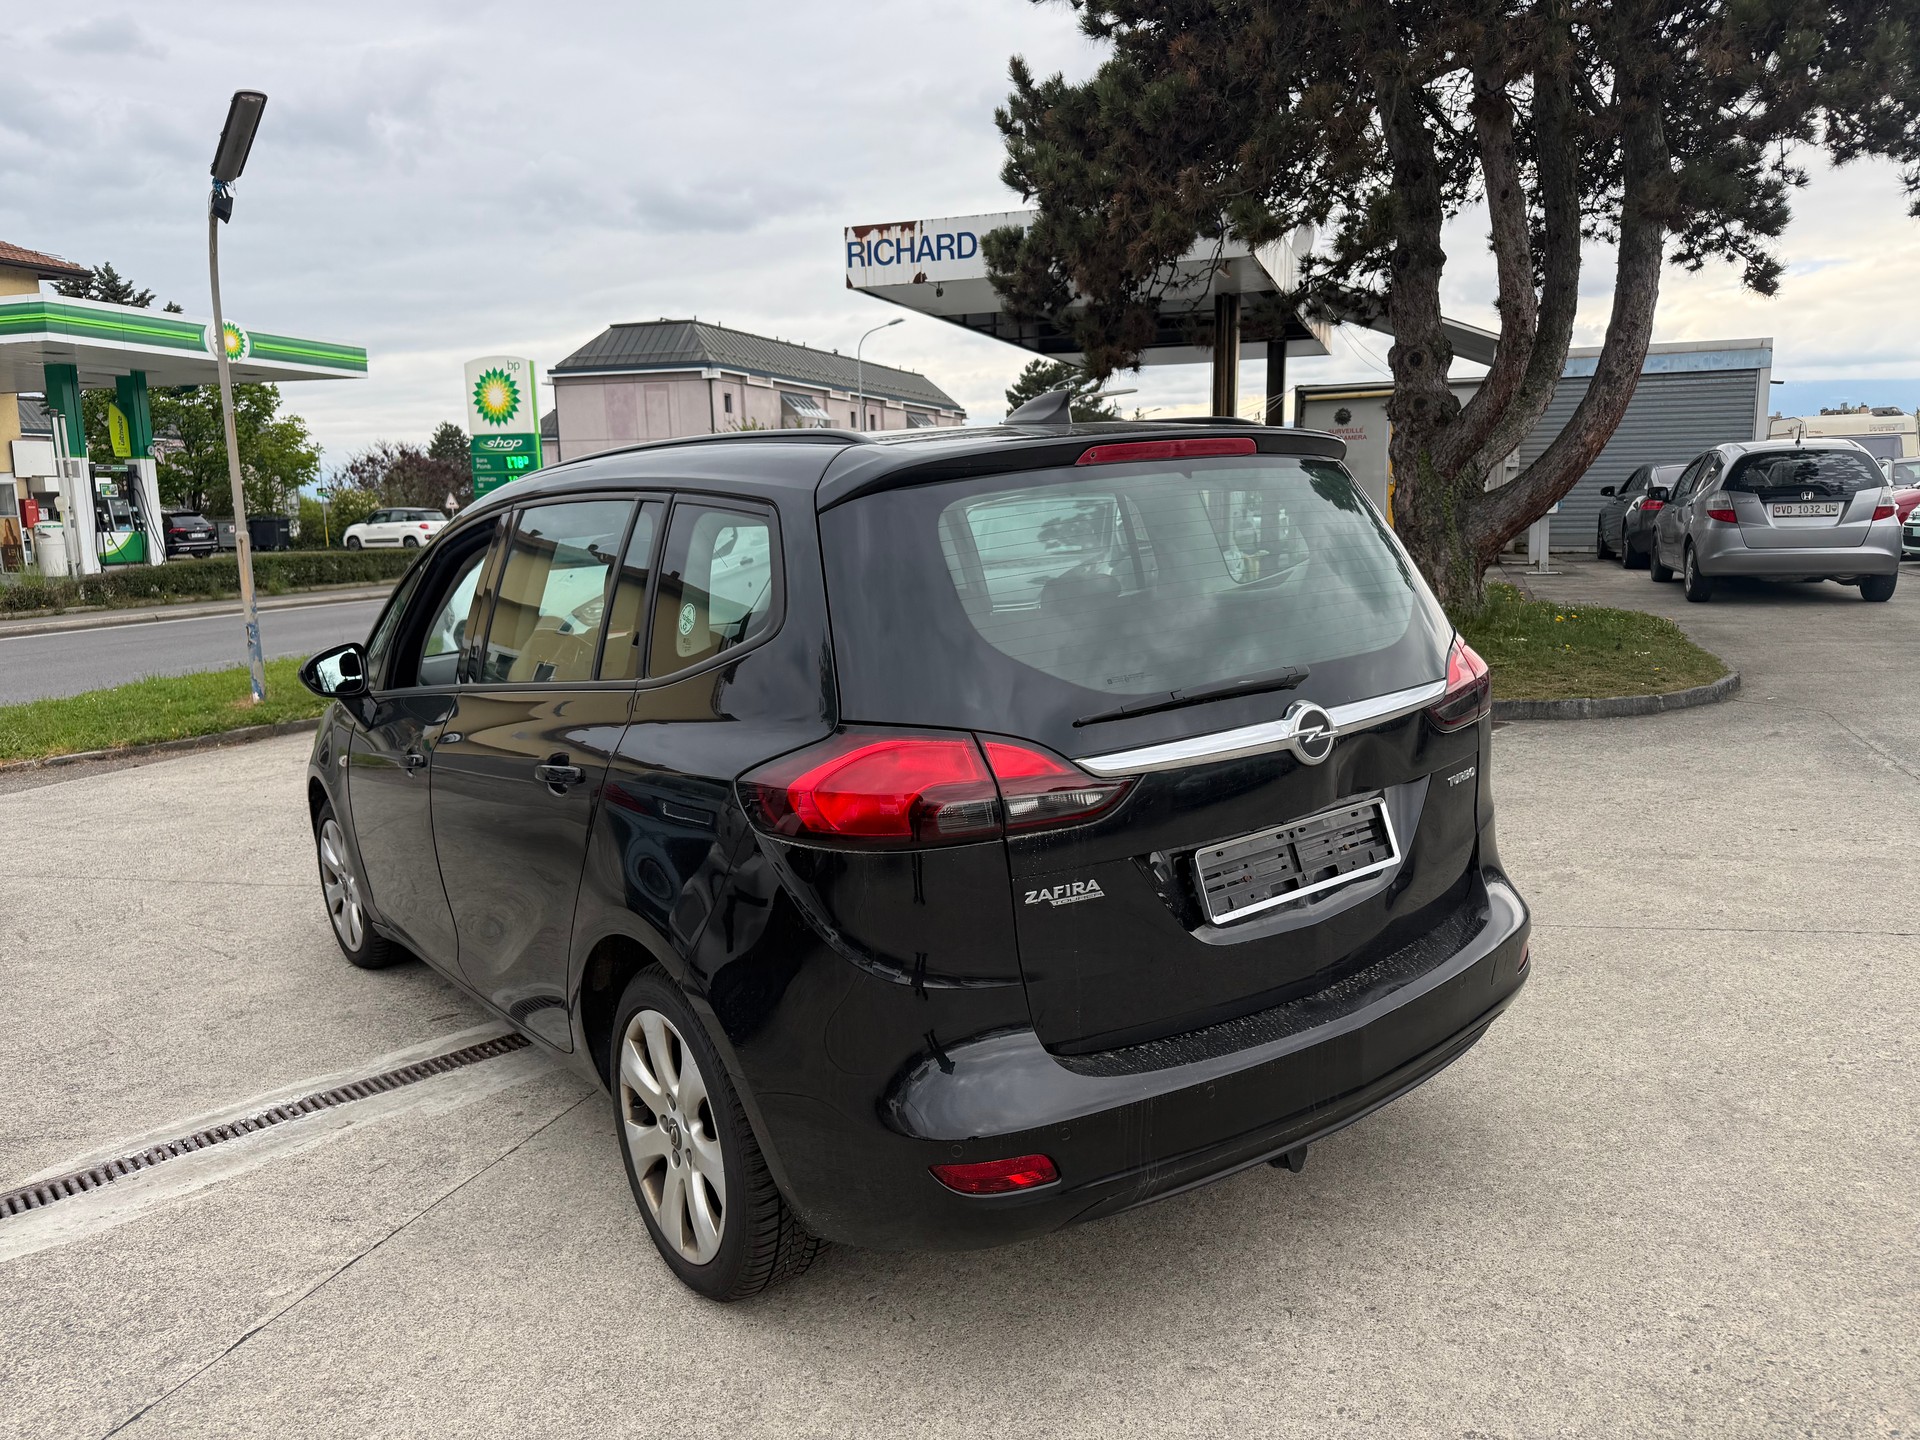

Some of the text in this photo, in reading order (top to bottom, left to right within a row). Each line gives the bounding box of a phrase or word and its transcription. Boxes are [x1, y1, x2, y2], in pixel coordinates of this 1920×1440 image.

[847, 232, 977, 268] RICHARD
[507, 360, 520, 372] bp
[487, 437, 522, 449] shop
[1448, 766, 1476, 786] TURBO
[1024, 880, 1101, 904] ZAFIRA
